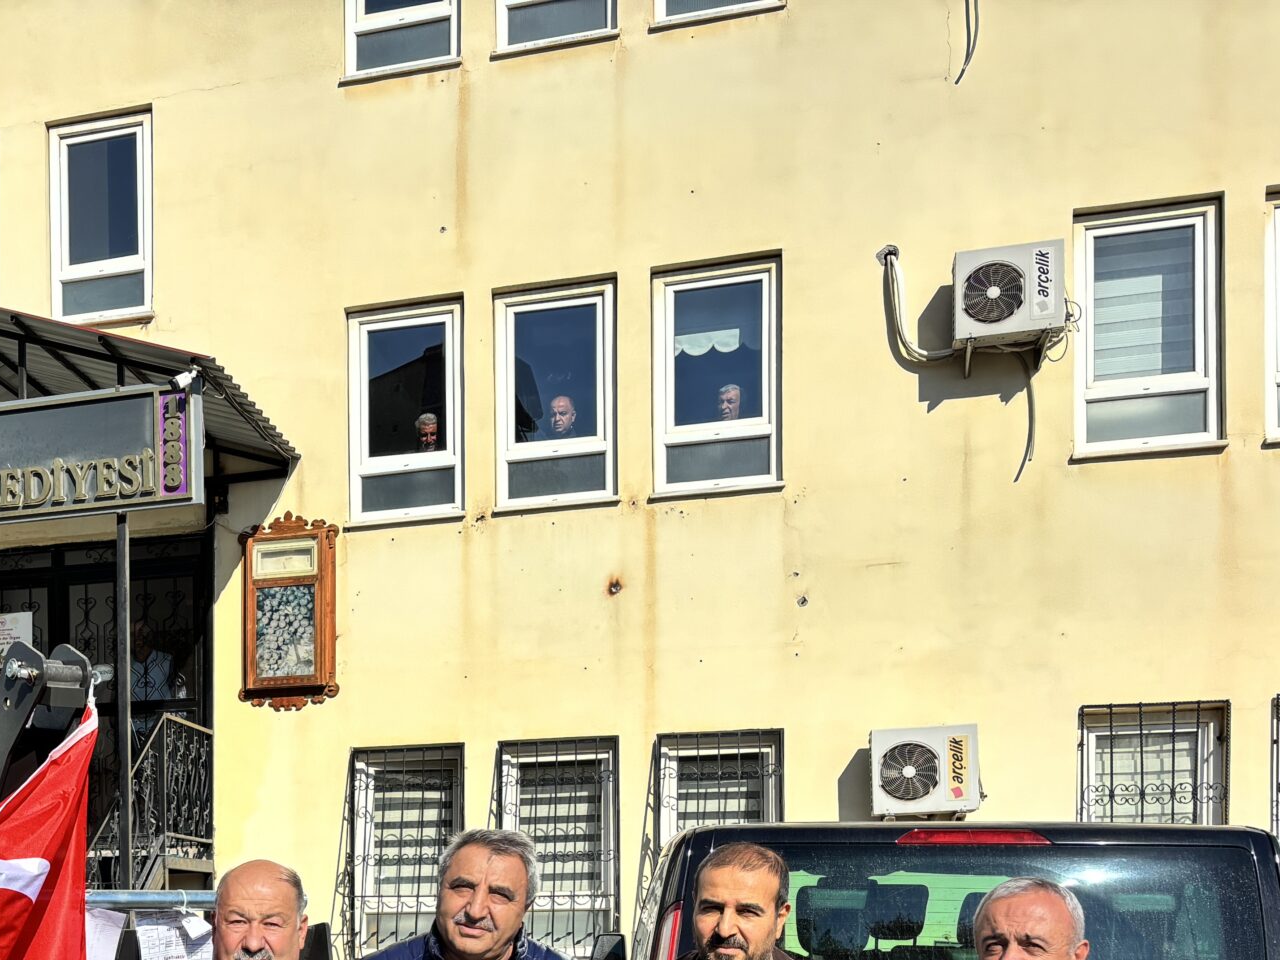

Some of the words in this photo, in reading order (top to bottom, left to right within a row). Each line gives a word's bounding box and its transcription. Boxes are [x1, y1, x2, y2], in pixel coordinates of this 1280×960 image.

[1035, 249, 1053, 298] arçelik
[163, 395, 183, 488] 1888
[949, 737, 967, 785] arçelik
